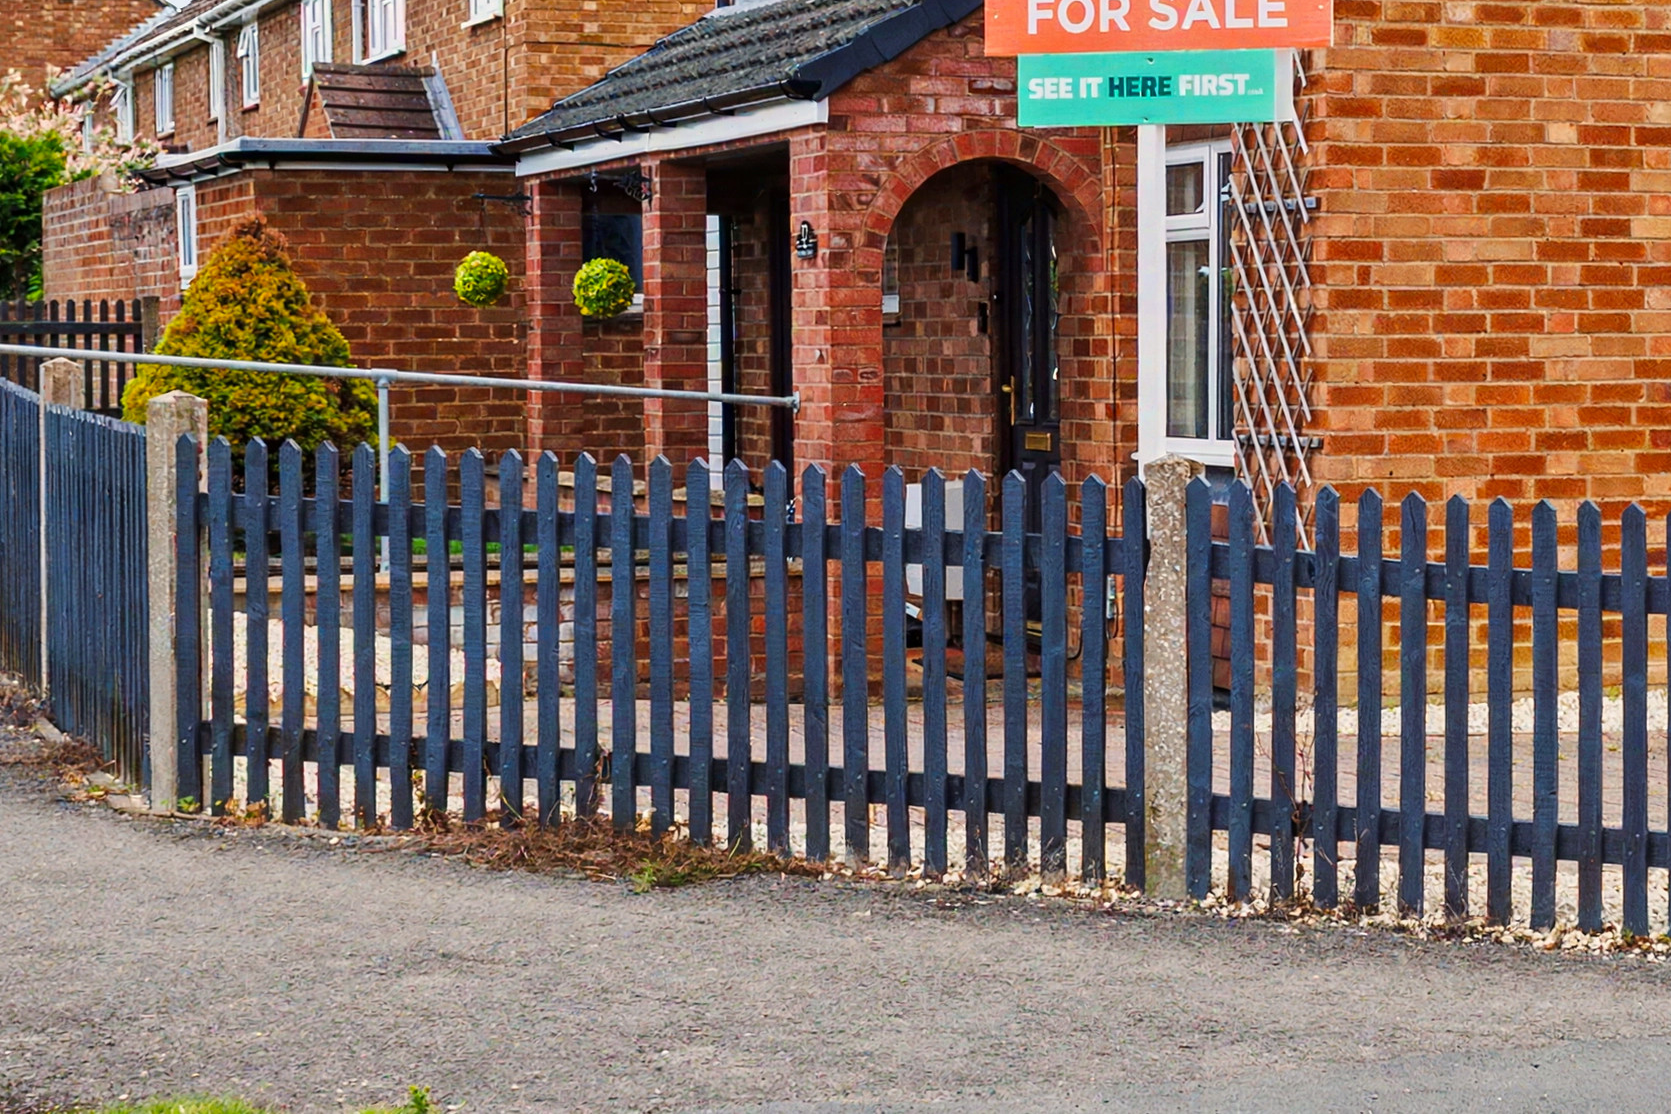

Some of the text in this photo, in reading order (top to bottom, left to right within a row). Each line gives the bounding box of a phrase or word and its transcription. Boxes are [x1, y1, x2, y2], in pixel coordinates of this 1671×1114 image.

[1028, 76, 1073, 99] SEE
[1079, 75, 1103, 98] IT
[1108, 75, 1172, 98] HERE
